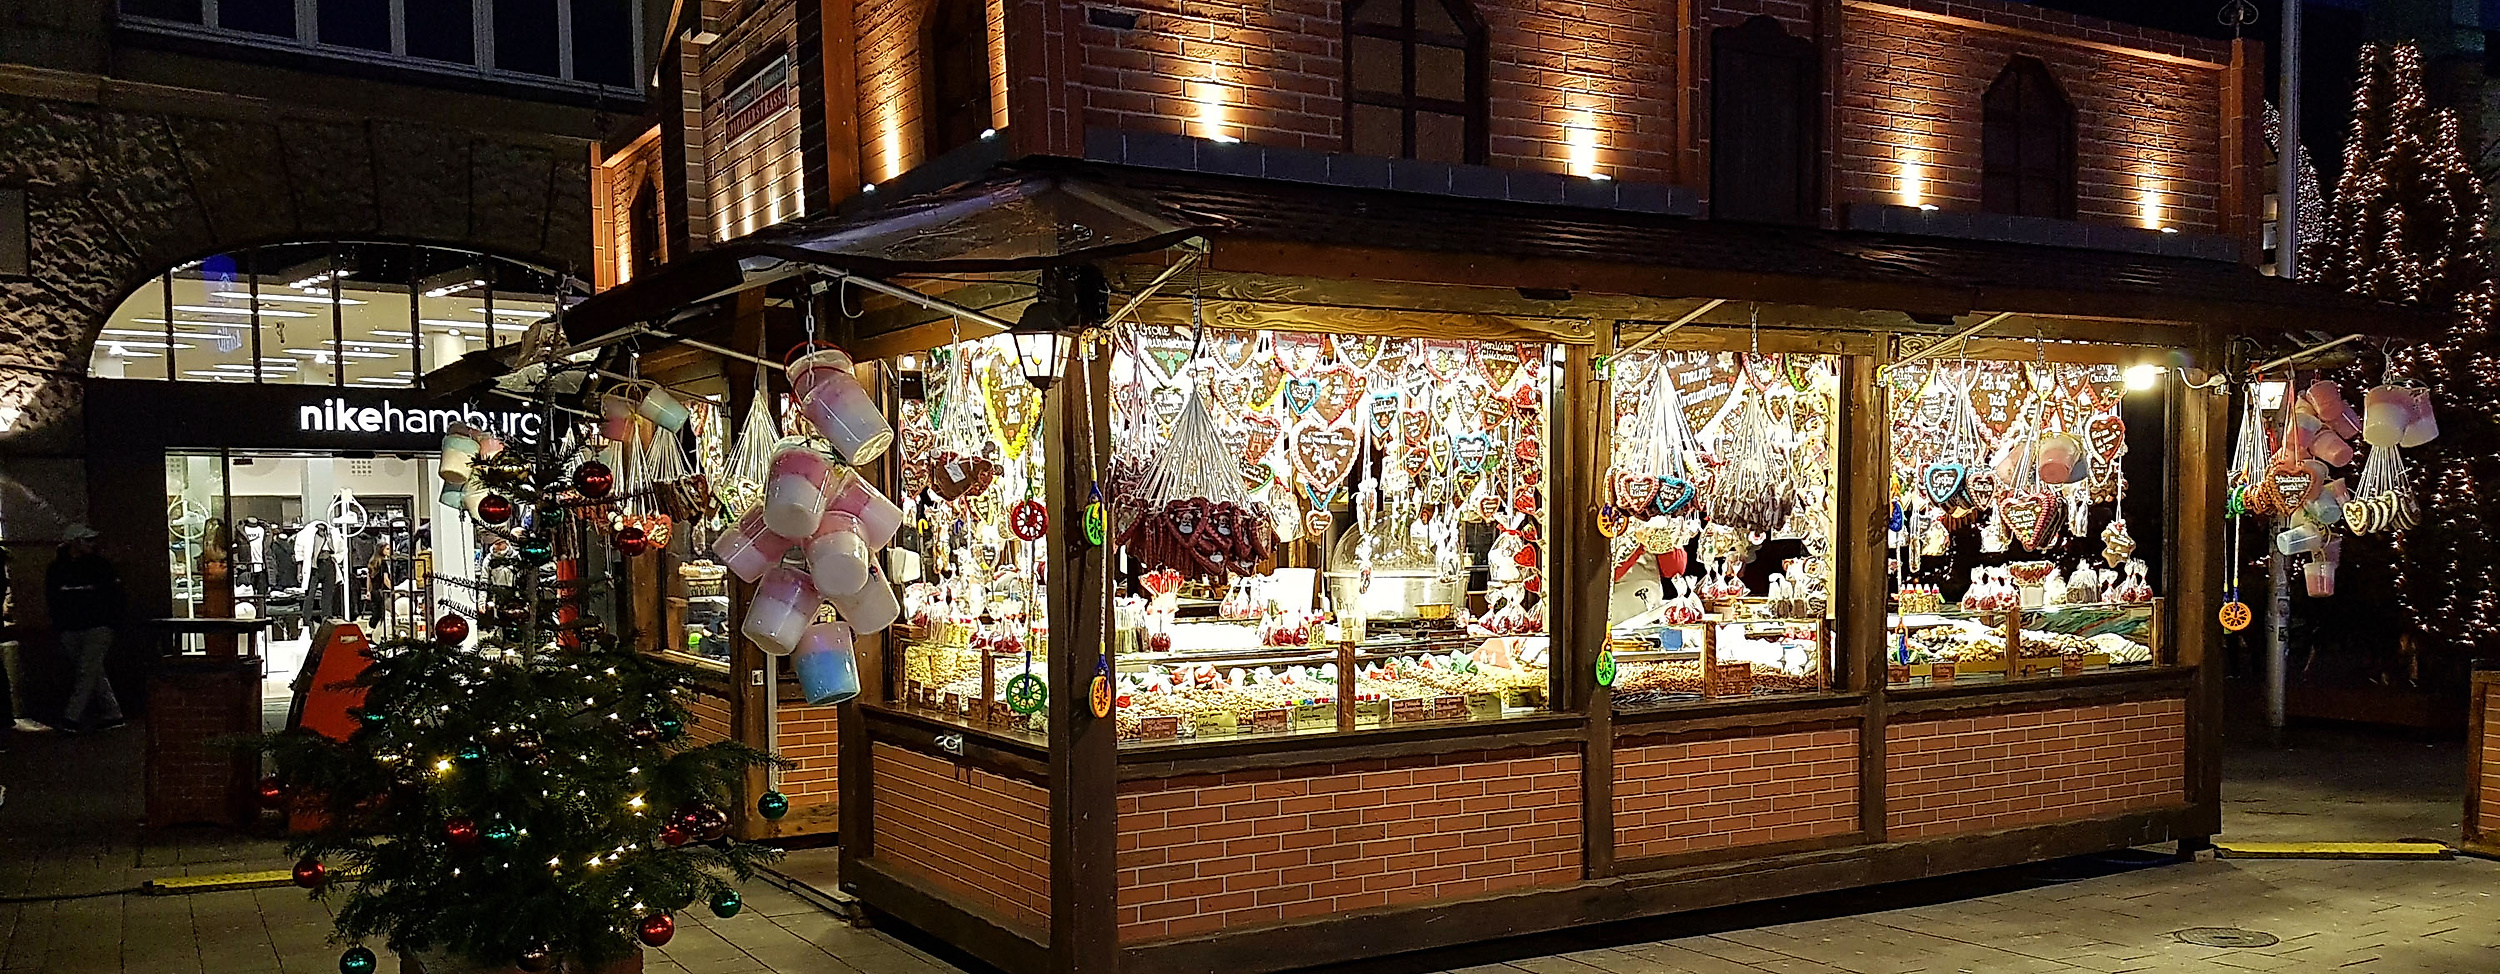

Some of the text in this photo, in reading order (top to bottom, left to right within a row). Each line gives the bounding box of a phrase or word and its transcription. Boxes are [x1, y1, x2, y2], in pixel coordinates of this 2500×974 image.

[1666, 350, 1709, 368] Du bist
[1679, 364, 1713, 386] meine
[1675, 379, 1729, 409] Traumfrau
[300, 398, 541, 444] nikehamburg
